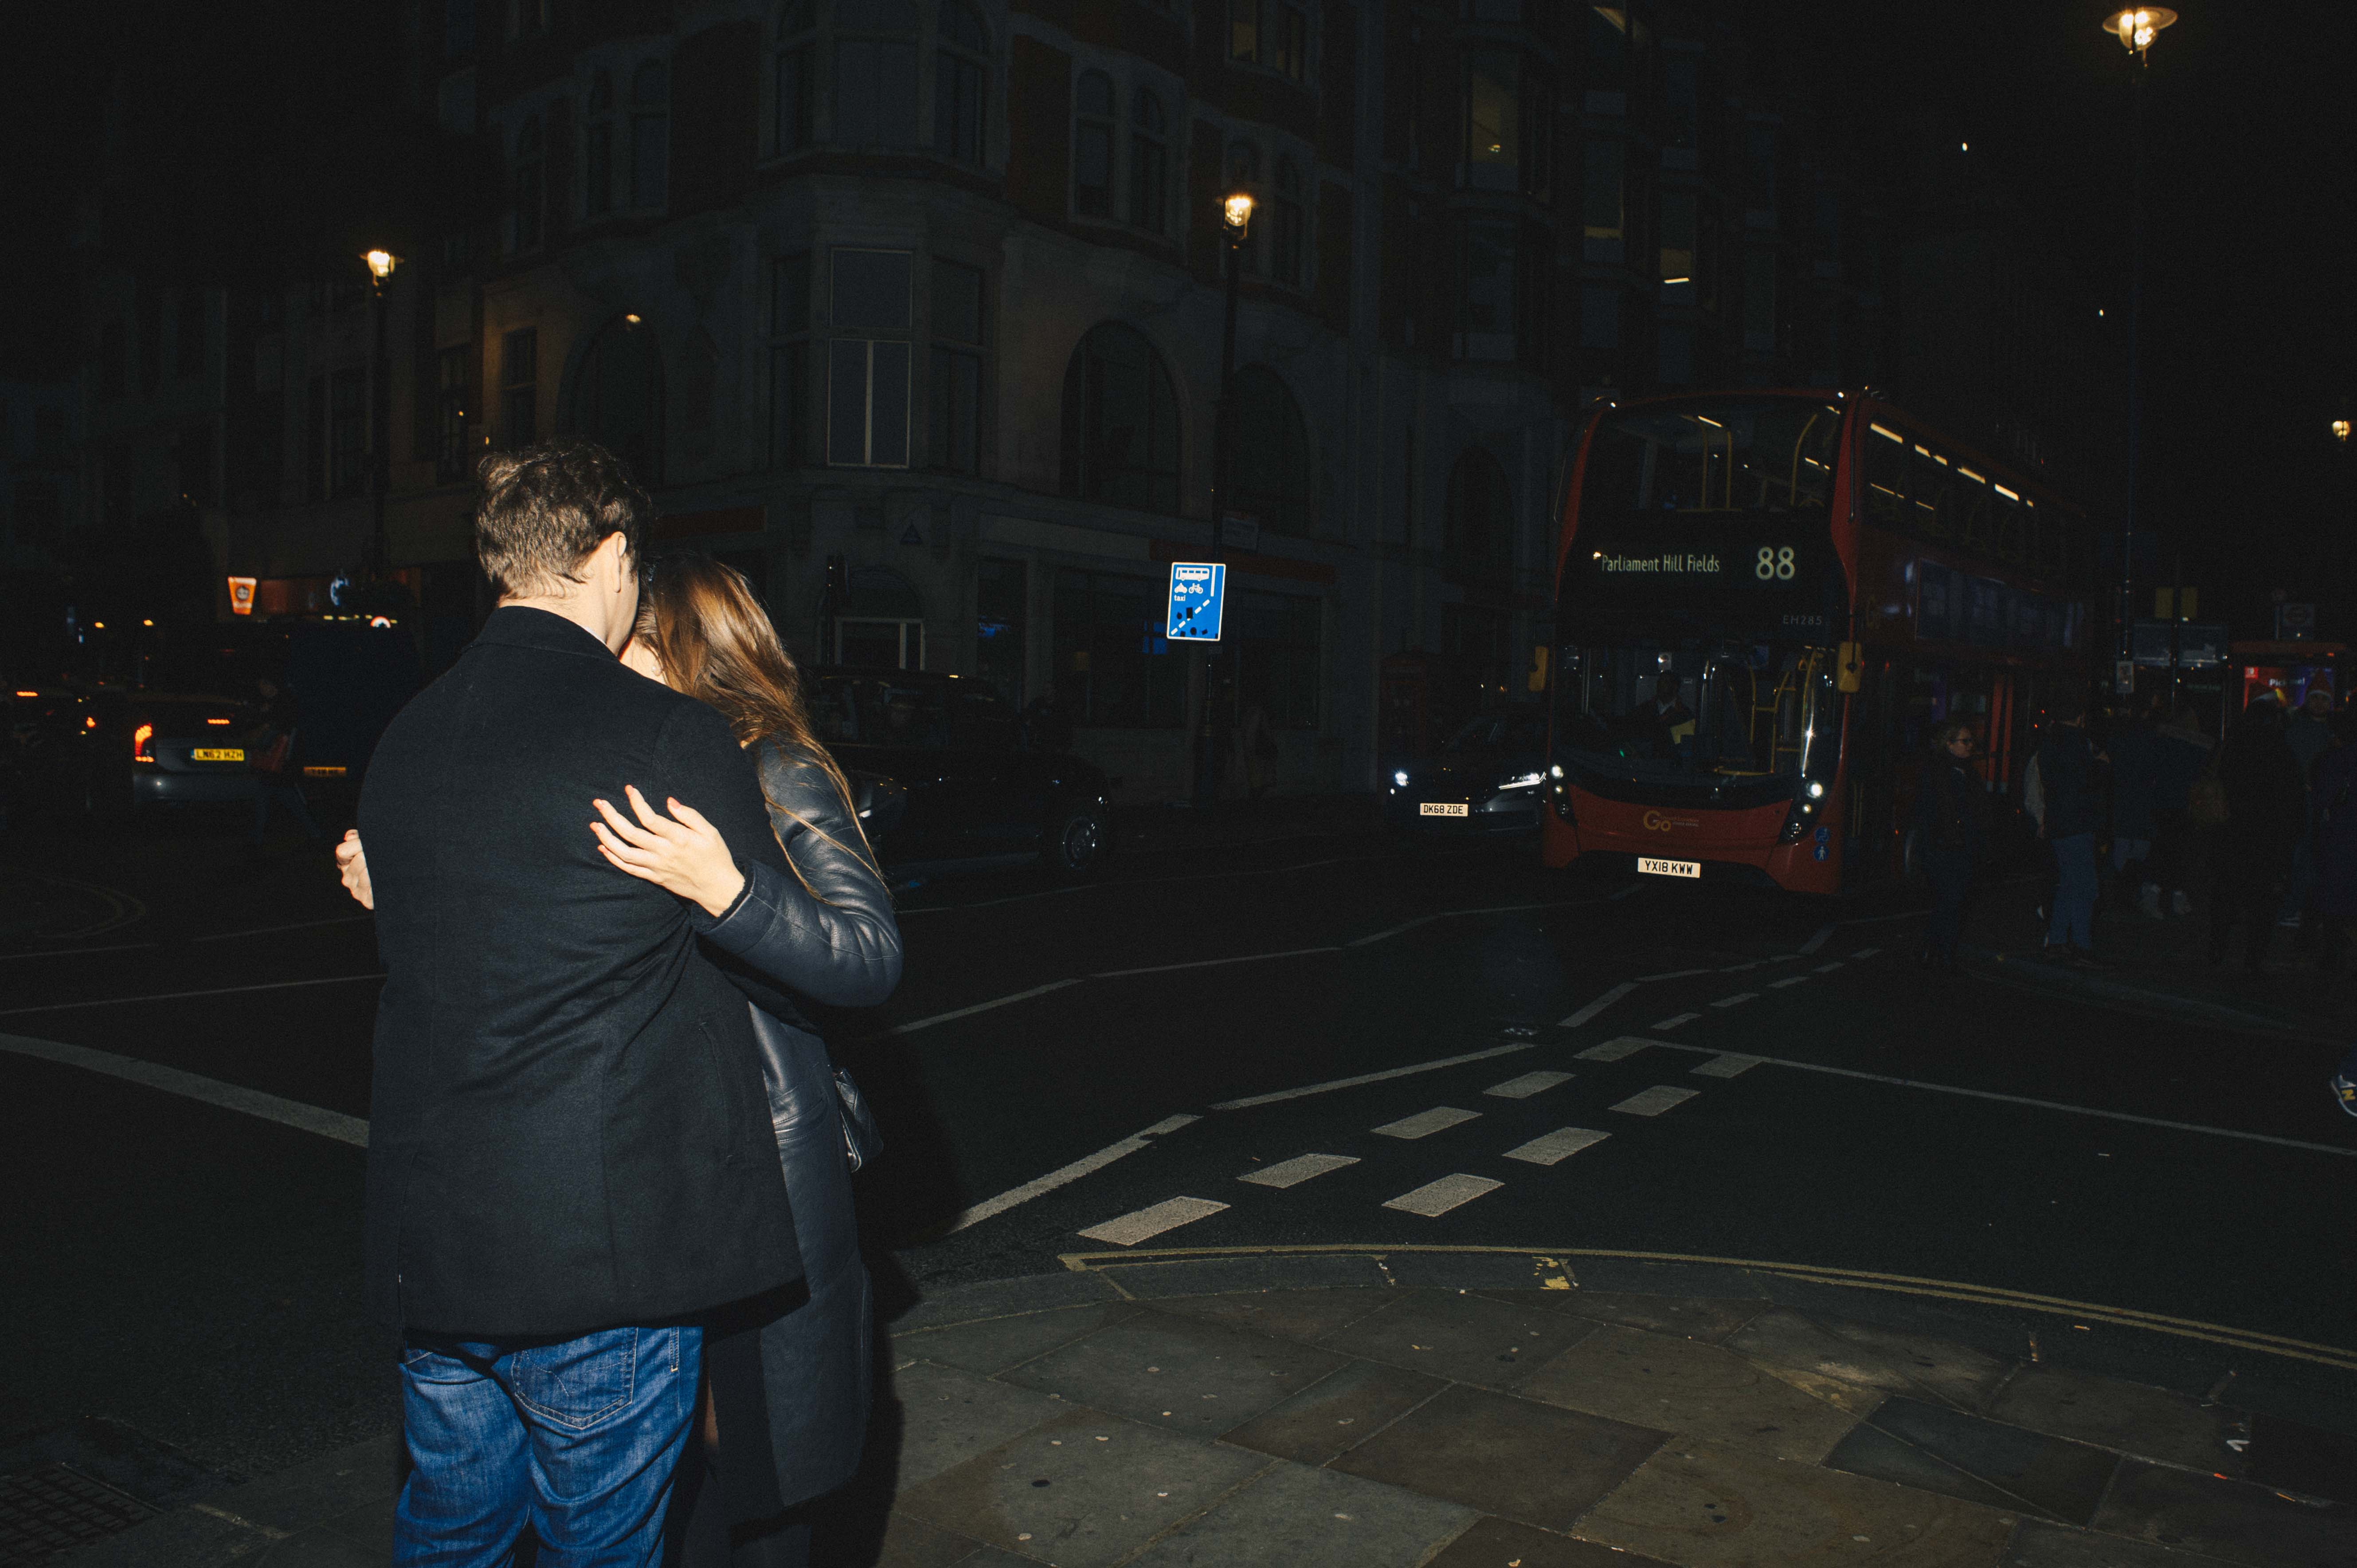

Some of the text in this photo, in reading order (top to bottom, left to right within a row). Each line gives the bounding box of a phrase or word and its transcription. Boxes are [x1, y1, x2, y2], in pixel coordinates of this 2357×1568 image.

[1601, 555, 1719, 571] Parliament Hill Fields
[1756, 546, 1795, 580] 88
[1782, 615, 1822, 625] EH285
[1423, 805, 1463, 814] DK68 ZDE
[1643, 810, 1672, 833] Go
[1645, 860, 1693, 875] YX18 KWW
